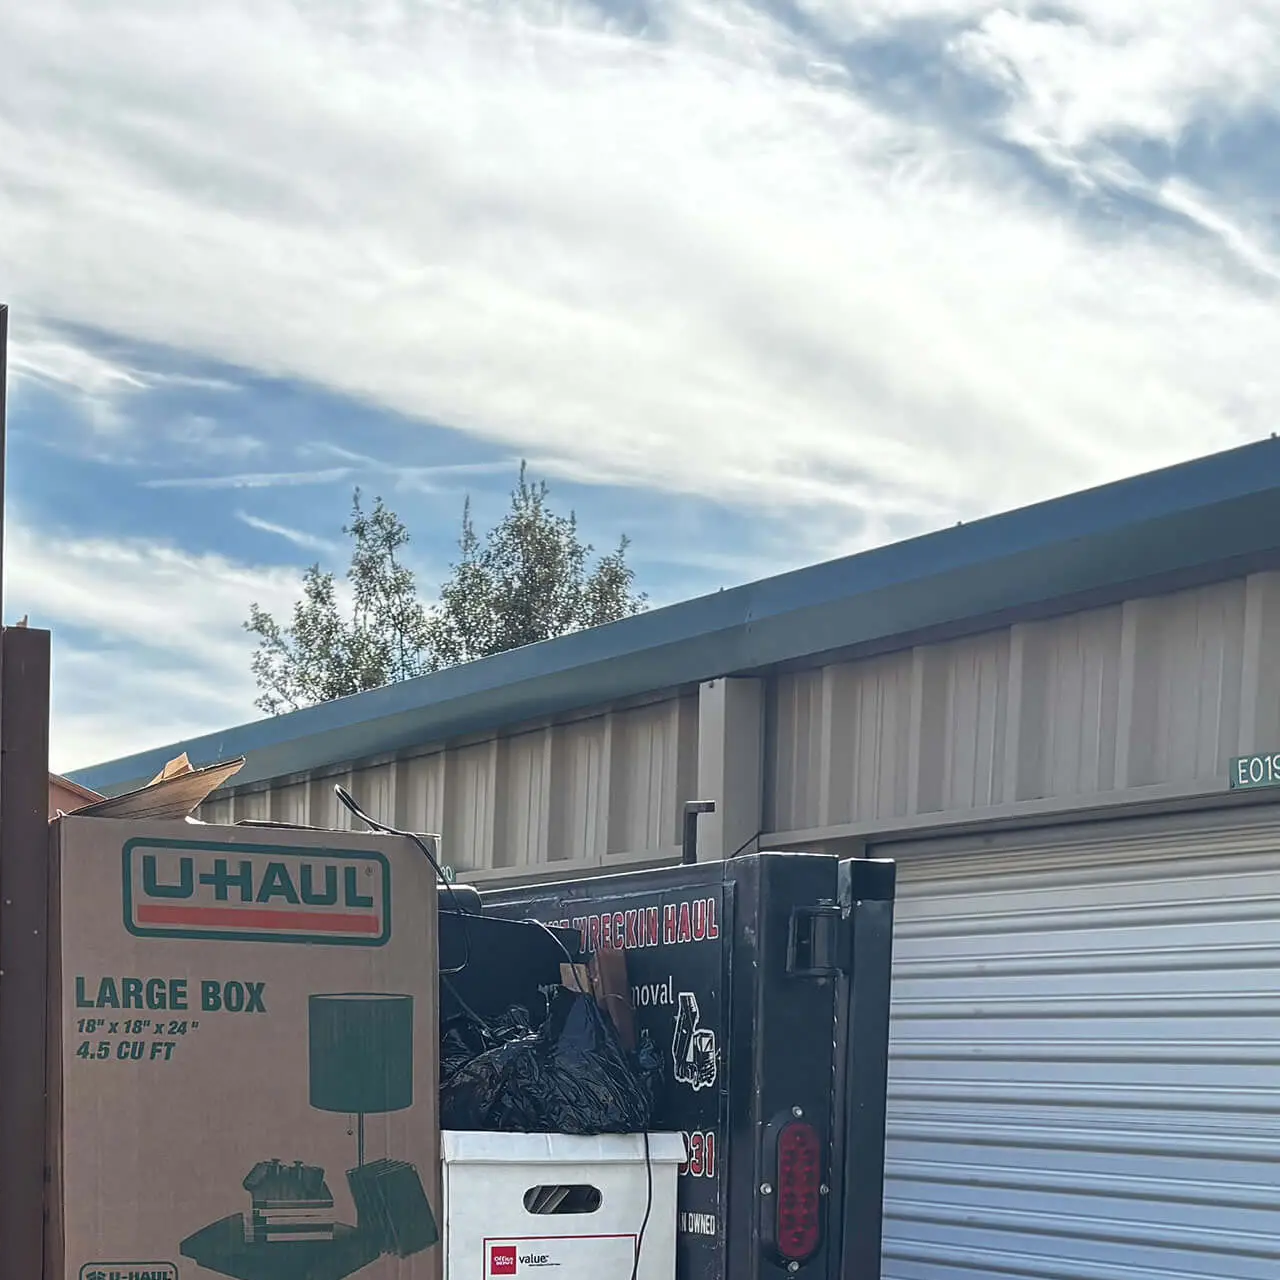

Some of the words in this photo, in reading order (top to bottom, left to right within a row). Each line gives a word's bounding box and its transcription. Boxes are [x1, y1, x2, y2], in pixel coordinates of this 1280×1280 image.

[142, 855, 374, 908] U-HAUL
[573, 907, 659, 954] WRECKIN
[663, 898, 719, 945] HAUL
[75, 976, 188, 1010] LARGE
[201, 980, 267, 1013] BOX
[77, 1018, 105, 1034] 18"
[107, 1022, 120, 1034] x
[123, 1019, 151, 1034] 18"
[154, 1023, 165, 1035] x
[76, 1040, 111, 1060] 4.5
[116, 1040, 146, 1060] CU
[150, 1041, 177, 1061] FT
[688, 1212, 716, 1236] OWNED
